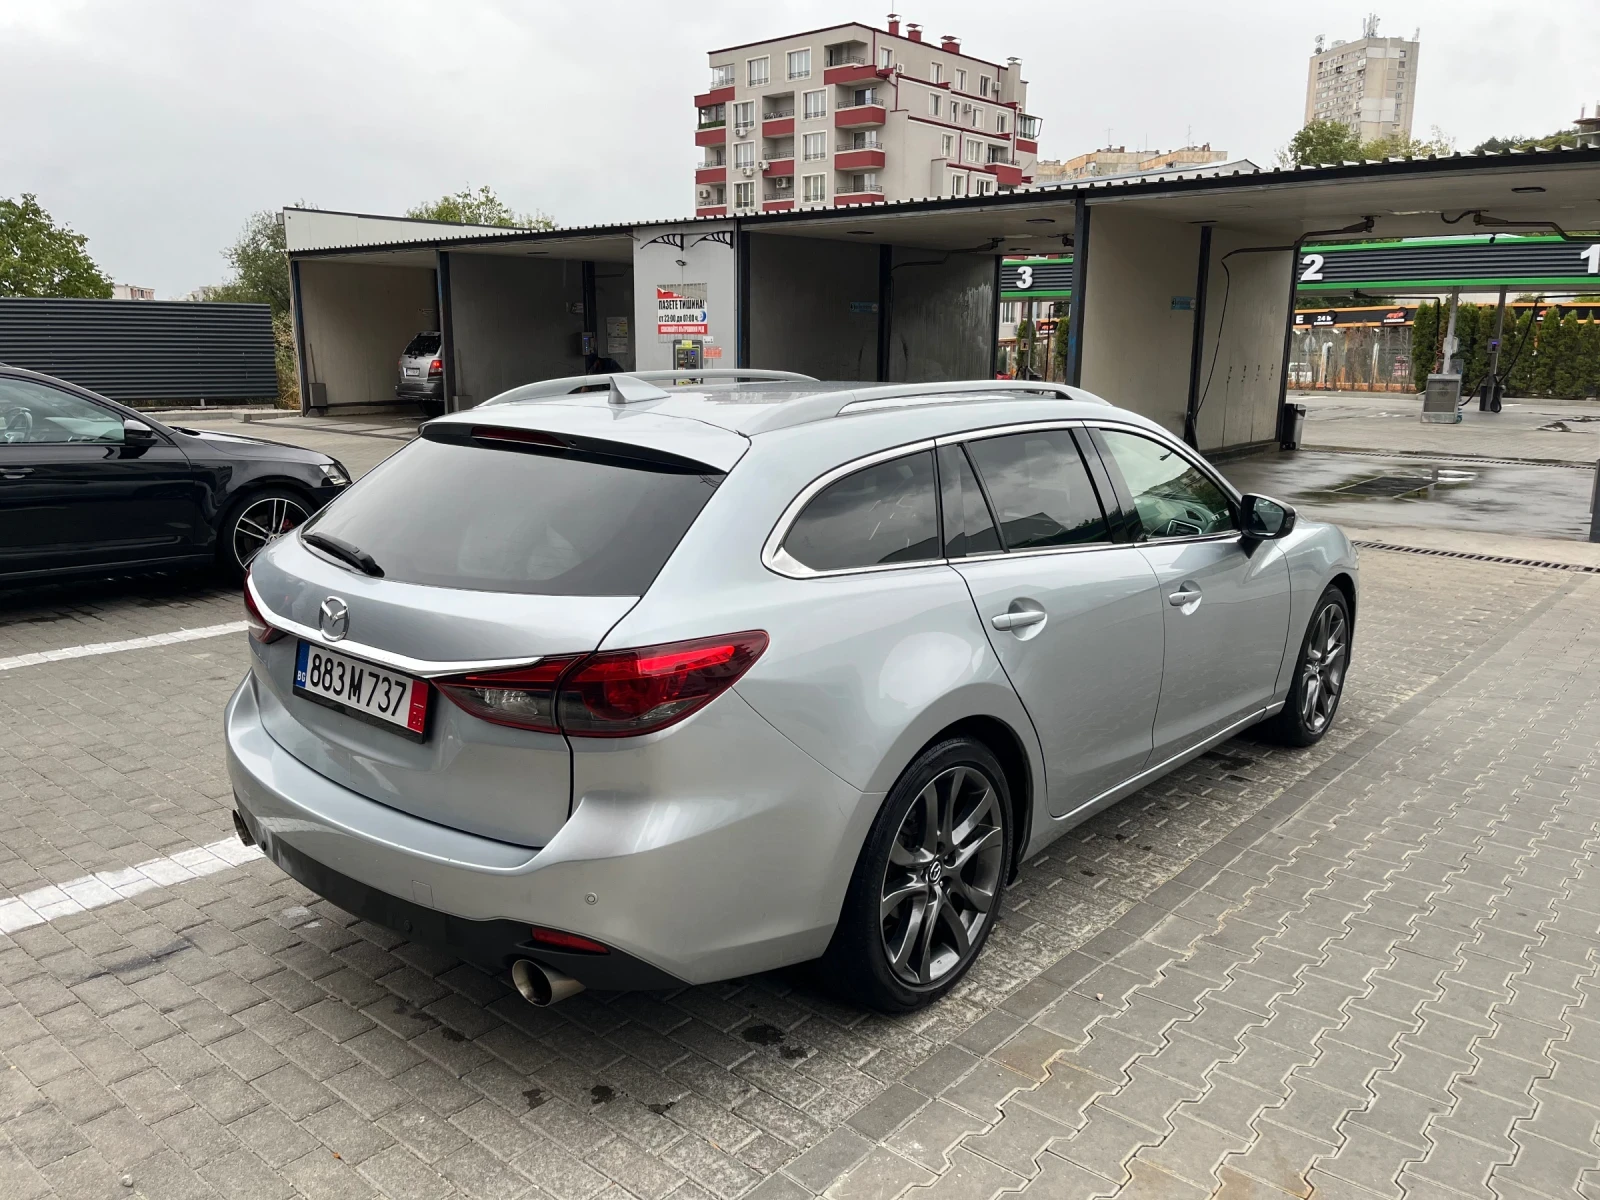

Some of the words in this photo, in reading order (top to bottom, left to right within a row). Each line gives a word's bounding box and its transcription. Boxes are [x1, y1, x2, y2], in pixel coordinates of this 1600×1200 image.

[1300, 254, 1324, 280] 2
[1580, 244, 1600, 273] 1
[1016, 266, 1033, 289] 3
[659, 300, 678, 310] ПАЗЕТЕ
[297, 670, 306, 683] BG
